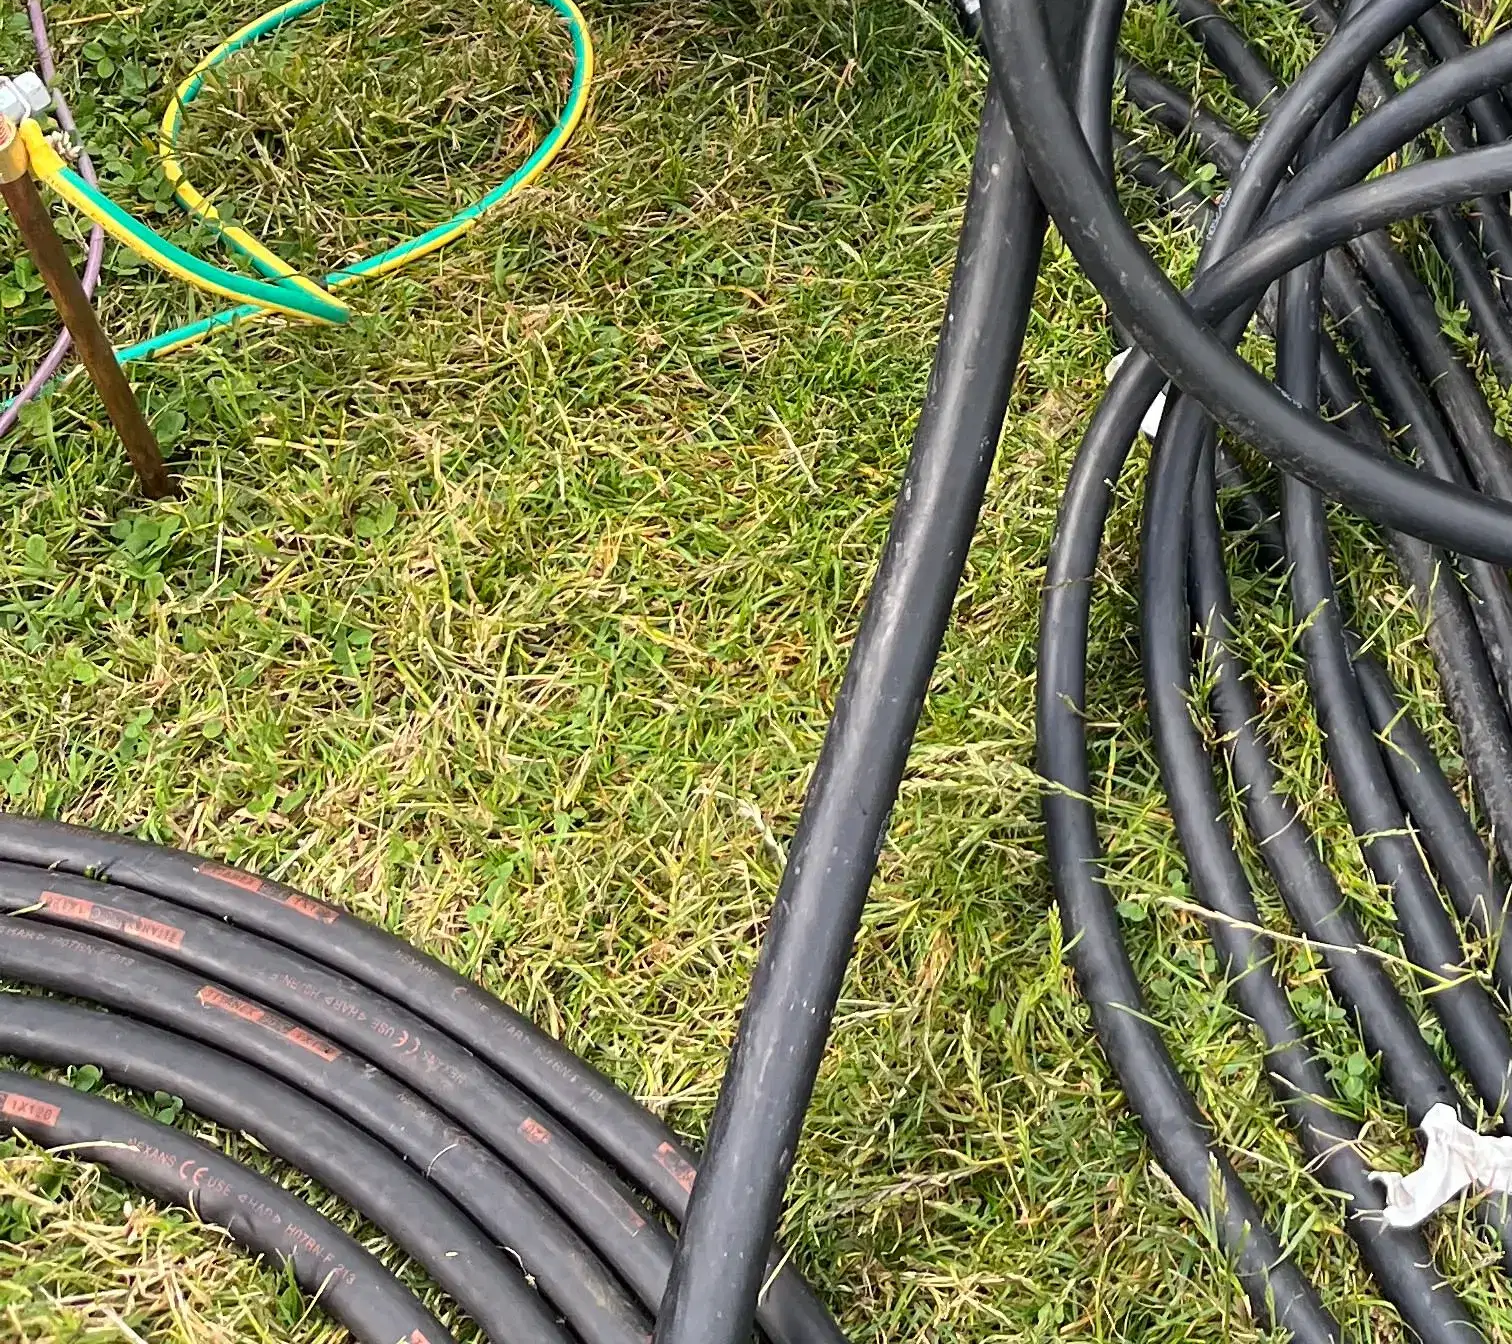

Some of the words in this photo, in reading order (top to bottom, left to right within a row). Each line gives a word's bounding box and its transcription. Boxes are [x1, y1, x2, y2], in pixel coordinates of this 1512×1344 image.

[12, 1099, 52, 1122] 1X120
[129, 1137, 176, 1167] NEXANS
[207, 1175, 231, 1196] USE
